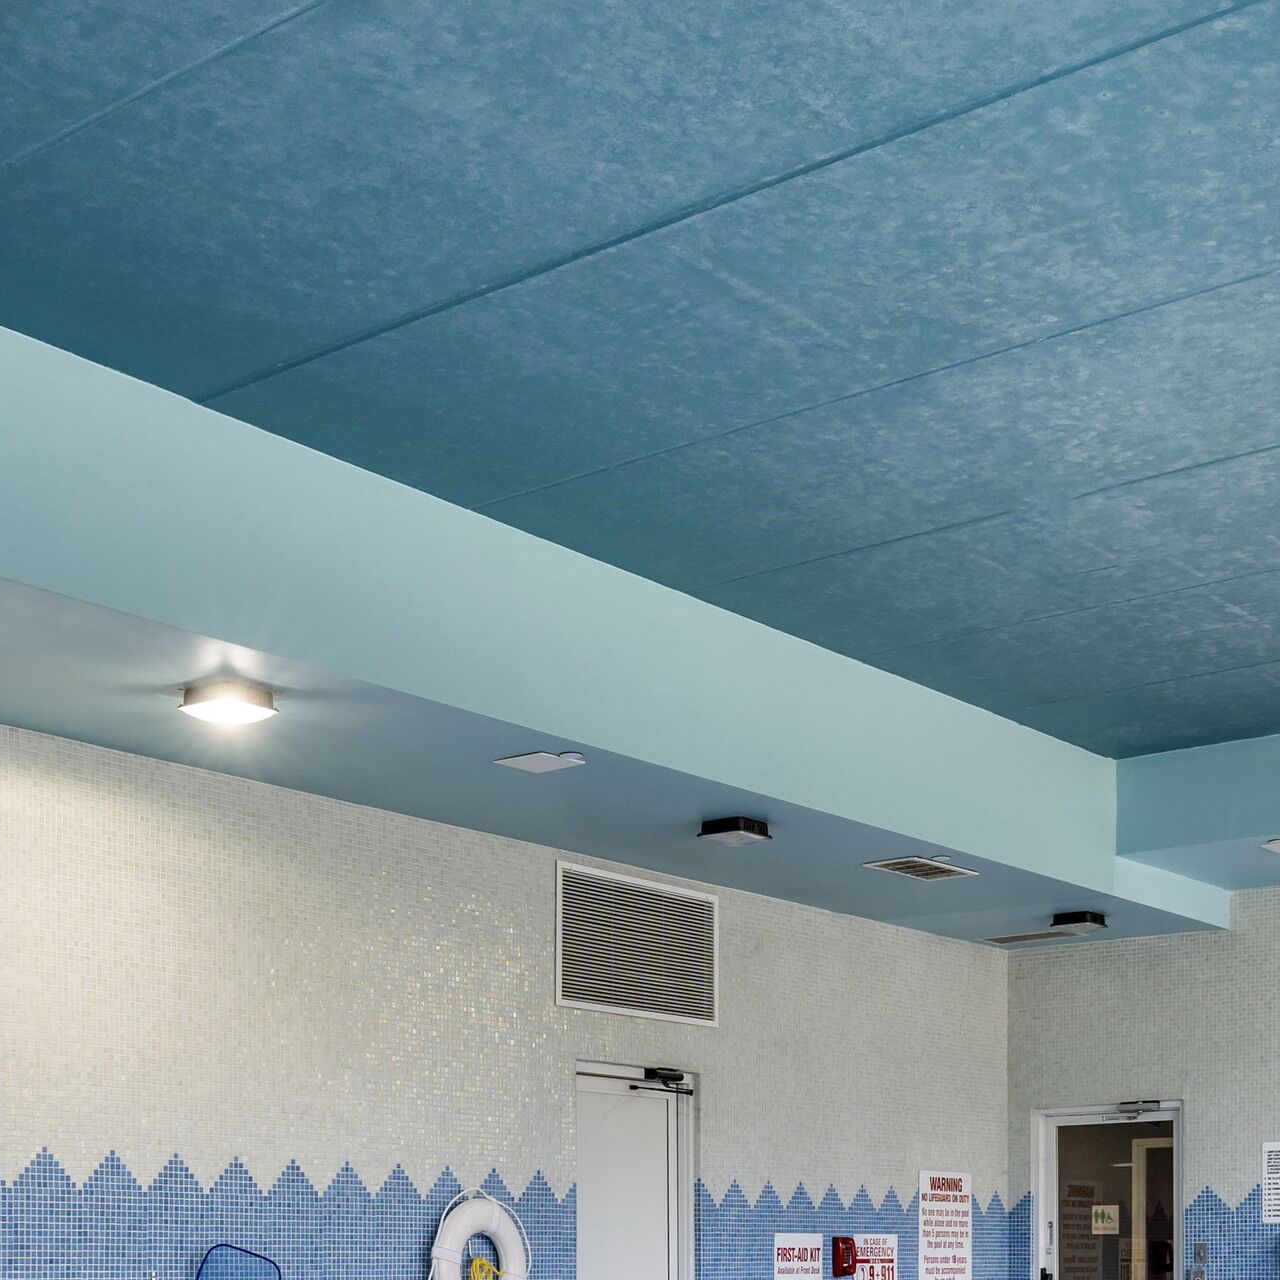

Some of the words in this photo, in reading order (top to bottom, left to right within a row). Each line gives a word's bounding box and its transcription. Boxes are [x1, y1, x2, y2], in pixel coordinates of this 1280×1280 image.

[929, 1176, 963, 1192] WARNING
[921, 1192, 927, 1202] NO
[929, 1193, 951, 1202] LIFEGUARD
[952, 1194, 958, 1203] ON
[959, 1194, 969, 1203] DUTY
[921, 1207, 927, 1216] No
[936, 1209, 944, 1218] may
[945, 1208, 949, 1216] be
[923, 1218, 933, 1226] while
[934, 1219, 944, 1227] alone
[923, 1229, 931, 1237] than
[935, 1230, 950, 1239] persons
[960, 1230, 964, 1238] be
[934, 1240, 942, 1249] pool
[777, 1247, 808, 1262] FIRST-AID
[810, 1248, 820, 1262] KIT
[857, 1246, 895, 1257] EMERGENCY
[924, 1255, 939, 1263] Persons
[940, 1255, 950, 1263] under
[957, 1257, 967, 1265] years
[801, 1266, 810, 1274] Front
[811, 1266, 820, 1274] Desk
[936, 1266, 940, 1274] be
[941, 1266, 965, 1275] accompanied
